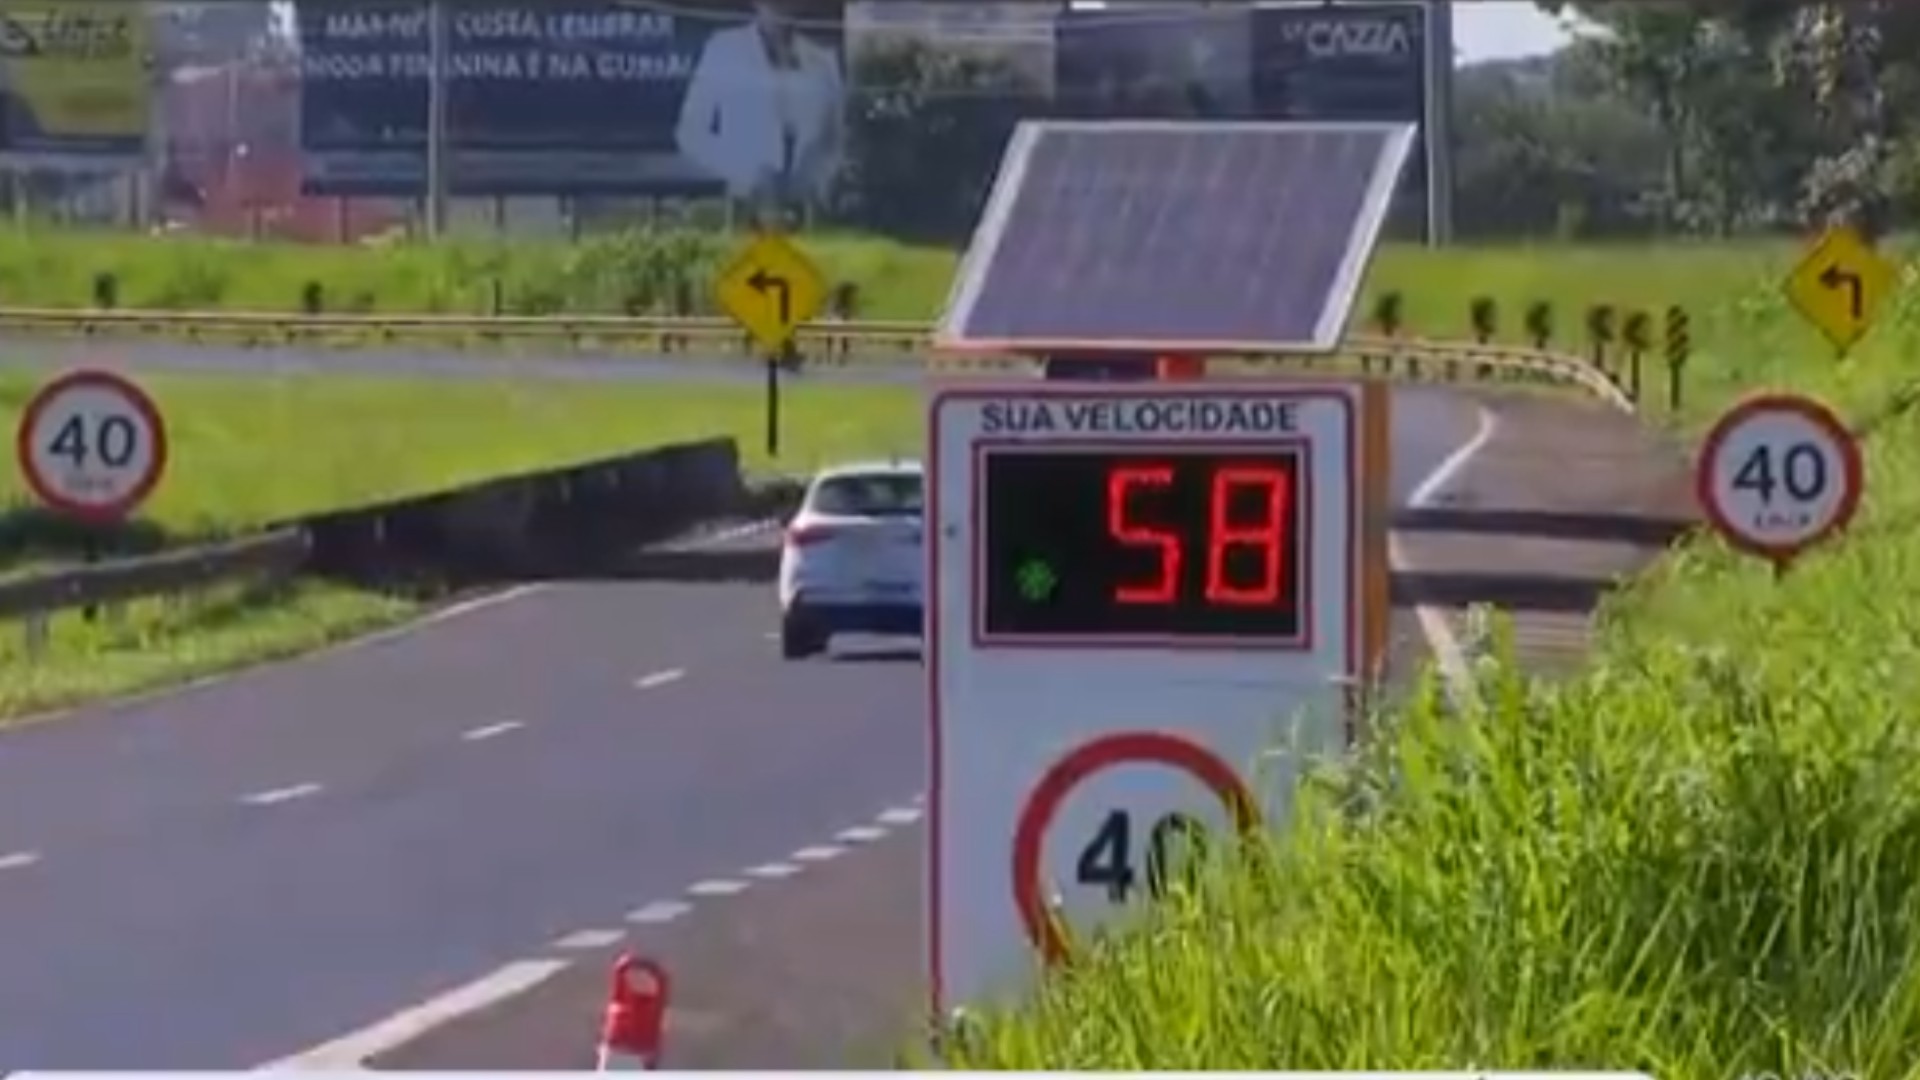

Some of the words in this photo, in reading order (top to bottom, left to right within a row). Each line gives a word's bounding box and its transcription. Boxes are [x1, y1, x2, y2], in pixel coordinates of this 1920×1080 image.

[1306, 20, 1411, 56] CAZZA
[49, 413, 137, 469] 40
[981, 402, 1055, 431] SUA
[1065, 400, 1298, 432] VELOCIDADE
[1732, 442, 1826, 505] 40
[1107, 466, 1288, 604] 58
[1076, 809, 1208, 903] 40
